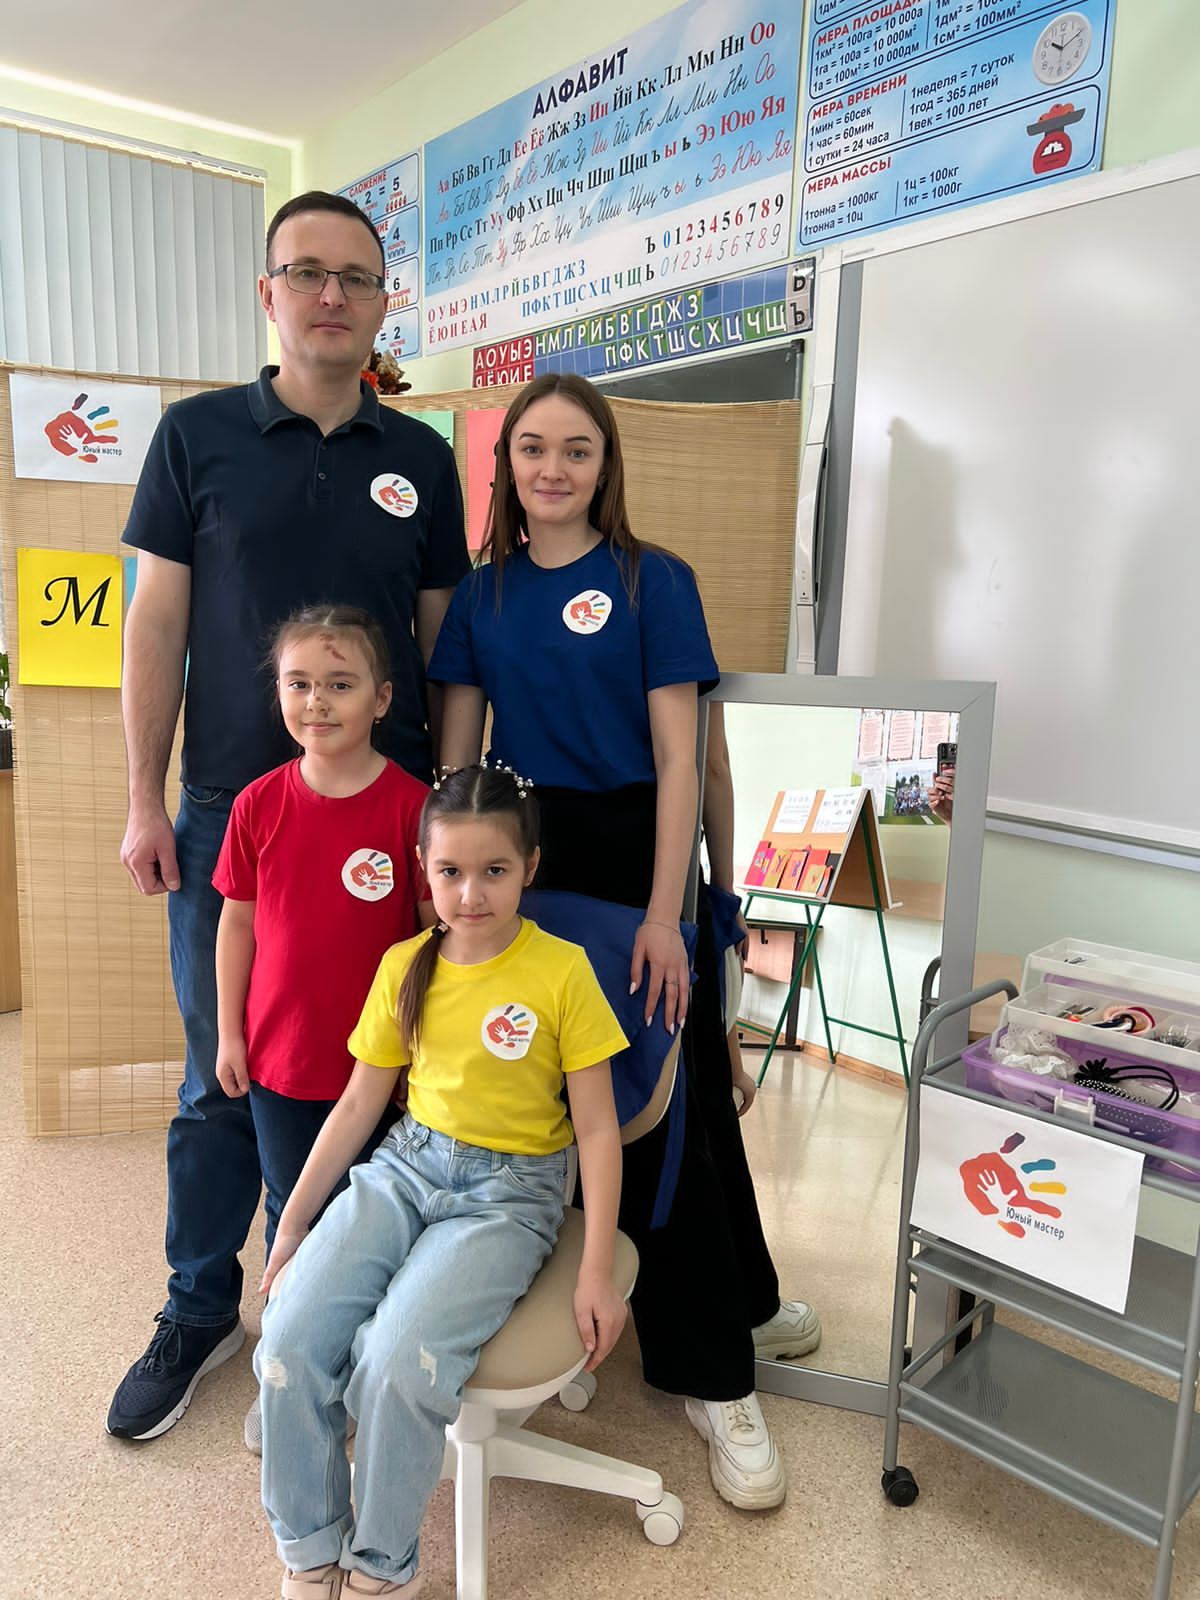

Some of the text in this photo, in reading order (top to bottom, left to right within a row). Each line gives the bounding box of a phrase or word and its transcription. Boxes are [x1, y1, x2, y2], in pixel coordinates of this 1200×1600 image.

[818, 24, 849, 46] МЕРА
[532, 48, 628, 119] АЛФАВИТ
[911, 73, 958, 99] 1неделя
[970, 64, 979, 78] 7
[980, 53, 1015, 75] суток
[452, 169, 464, 188] Бб
[467, 164, 480, 181] Вв
[482, 155, 494, 174] Гг
[514, 140, 527, 158] Ее
[530, 127, 545, 151] Ёё
[547, 120, 570, 143] Жж
[573, 112, 586, 131] Зз
[590, 101, 608, 123] Ии
[613, 86, 632, 112] Йй
[637, 78, 657, 100] Кк
[660, 65, 682, 88] Лл
[687, 50, 715, 76] Мм
[720, 35, 745, 61] Нн
[750, 21, 776, 45] Оо
[812, 73, 908, 120] МЕРА ВРЕМЕНИ
[909, 98, 934, 115] 1год
[946, 85, 967, 103] 365
[968, 73, 999, 97] дней
[811, 121, 834, 136] 1мин
[844, 106, 872, 124] 60сек
[908, 116, 933, 132] 1век
[945, 103, 965, 120] 100
[967, 97, 989, 113] лет
[815, 148, 841, 166] сутки
[852, 139, 864, 153] 24
[866, 131, 890, 147] часа
[816, 135, 833, 149] час
[843, 121, 874, 140] 60мин
[430, 237, 443, 254] Пп
[446, 232, 457, 250] Рр
[460, 225, 472, 241] Сс
[474, 218, 488, 235] Тт
[507, 201, 525, 223] Фф
[547, 187, 563, 208] Цц
[567, 178, 583, 196] Чч
[588, 167, 614, 190] Шш
[619, 153, 648, 177] Щщ
[696, 124, 715, 146] Ээ
[720, 110, 755, 136] Юю
[760, 95, 785, 121] Яя
[807, 156, 892, 194] МЕРА МАССЫ
[904, 178, 917, 191] 1ц
[929, 166, 960, 182] 100кг
[365, 191, 372, 205] 2
[393, 176, 400, 191] 5
[805, 204, 836, 221] 1тонна
[847, 190, 879, 208] 1000кг
[903, 195, 919, 207] 1кг
[932, 181, 963, 200] 1000г
[393, 227, 400, 240] 4
[803, 219, 835, 236] 1тонна
[847, 211, 864, 225] 10ц
[393, 277, 400, 291] 6
[394, 327, 400, 340] 2
[1006, 1206, 1065, 1240] Юный мастер
